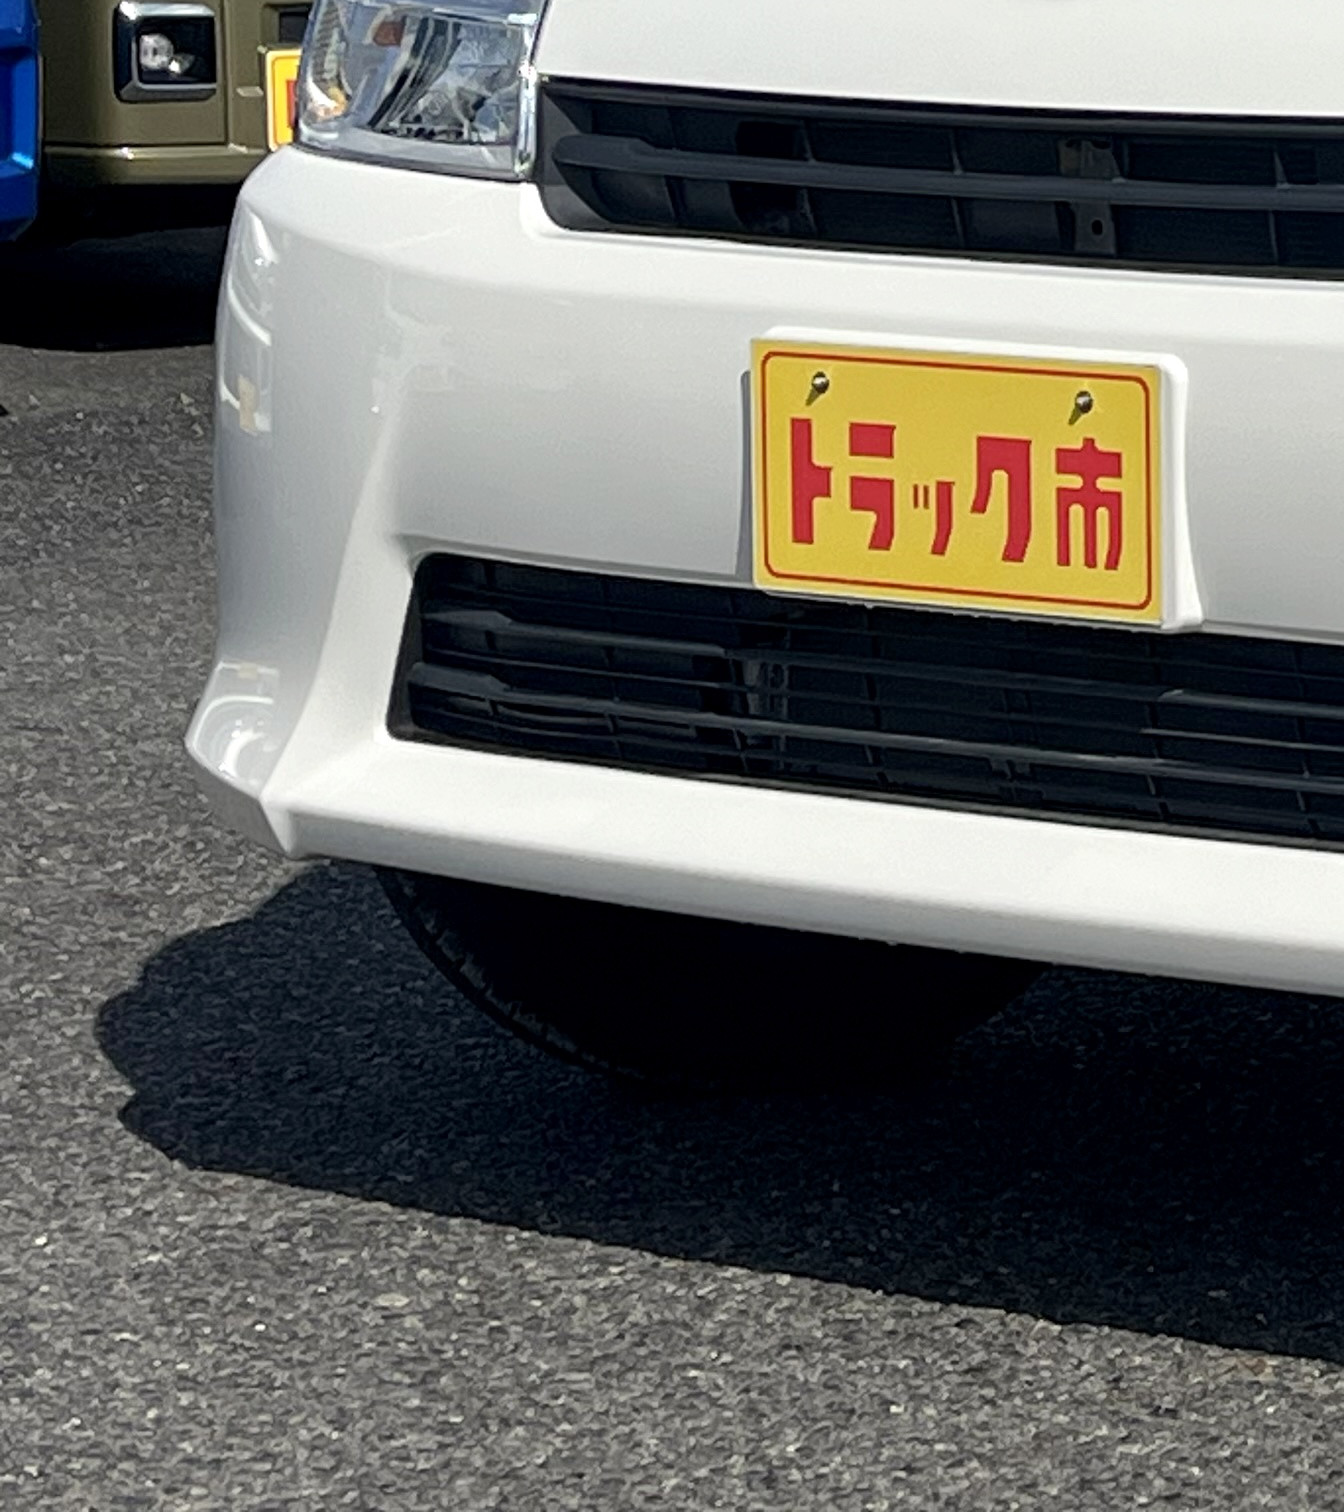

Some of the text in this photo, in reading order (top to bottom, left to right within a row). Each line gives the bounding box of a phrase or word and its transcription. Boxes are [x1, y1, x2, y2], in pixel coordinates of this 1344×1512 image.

[790, 417, 1122, 571] トラック市
